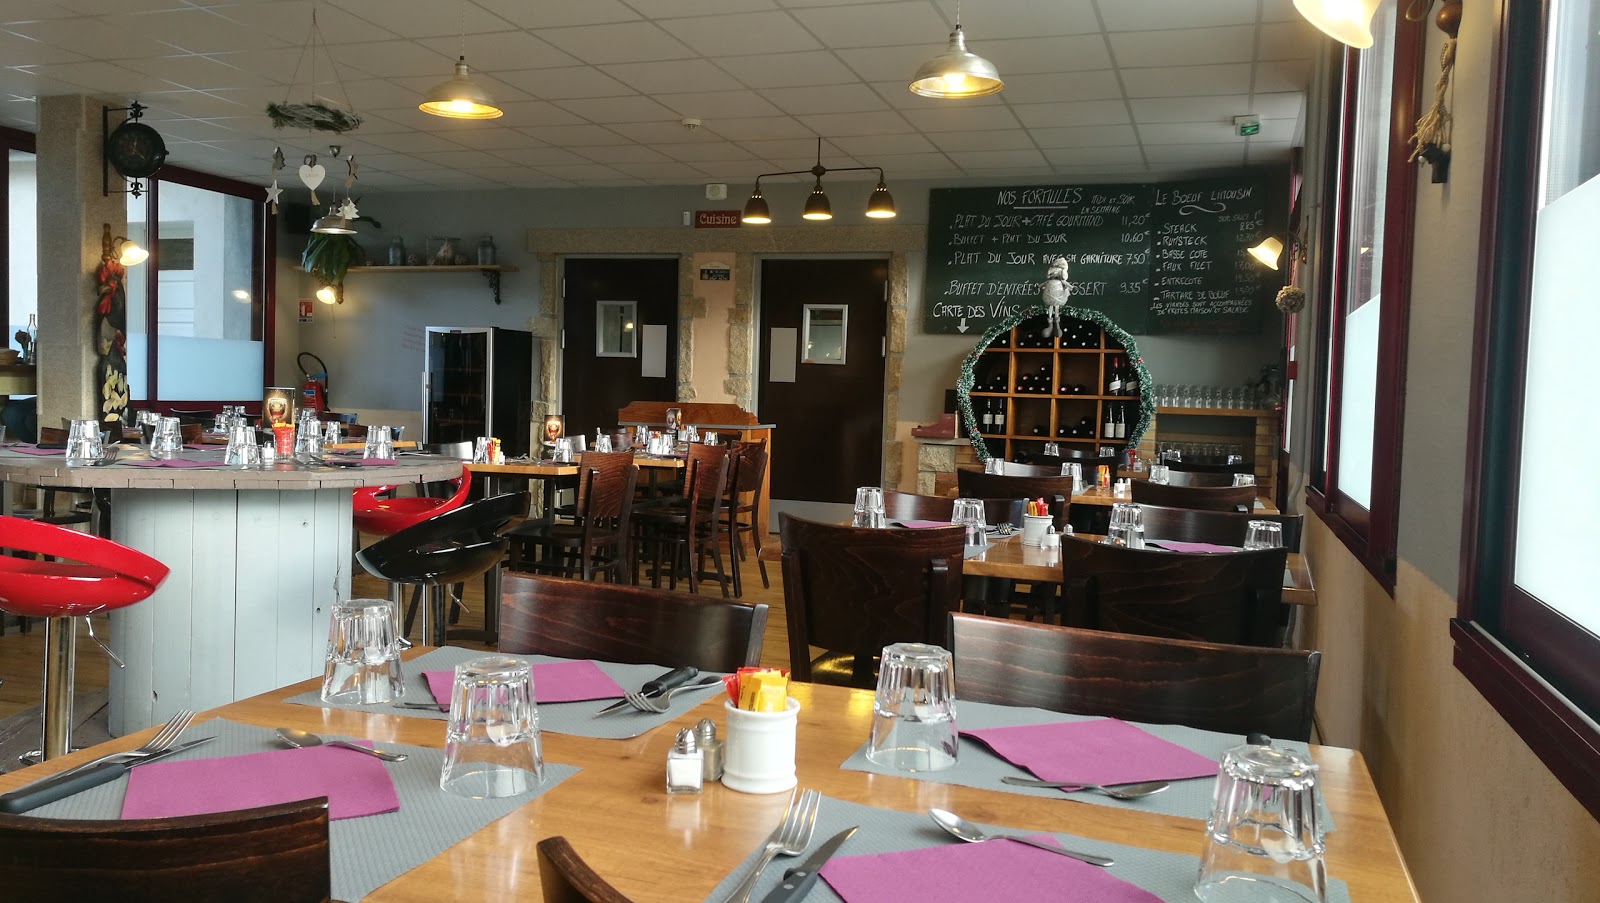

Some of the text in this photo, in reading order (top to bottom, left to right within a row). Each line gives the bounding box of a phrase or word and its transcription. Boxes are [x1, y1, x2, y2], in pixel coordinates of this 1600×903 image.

[997, 188, 1083, 205] NOS FORMULES
[699, 213, 737, 225] Cuisine
[954, 213, 977, 228] PLAT
[978, 214, 992, 228] DU
[993, 214, 1022, 228] JOUR
[1056, 214, 1104, 227] GOURMAND
[1162, 222, 1197, 235] STEACK
[953, 233, 985, 246] BUFFET
[1002, 233, 1021, 244] PLAT
[1027, 234, 1041, 244] DU
[1043, 233, 1068, 244] JOUR
[954, 250, 981, 265] PLAT
[987, 251, 1001, 264] DU
[1006, 251, 1036, 265] JOUR
[1162, 249, 1185, 260] BASSE
[1162, 261, 1182, 271] FAUX
[1190, 261, 1213, 271] FILET
[948, 279, 985, 296] BUFFET
[1070, 281, 1107, 296] SSERT
[1160, 290, 1194, 301] TARTARE
[1197, 291, 1207, 301] DE
[932, 301, 964, 318] CARTE
[967, 304, 986, 319] DES
